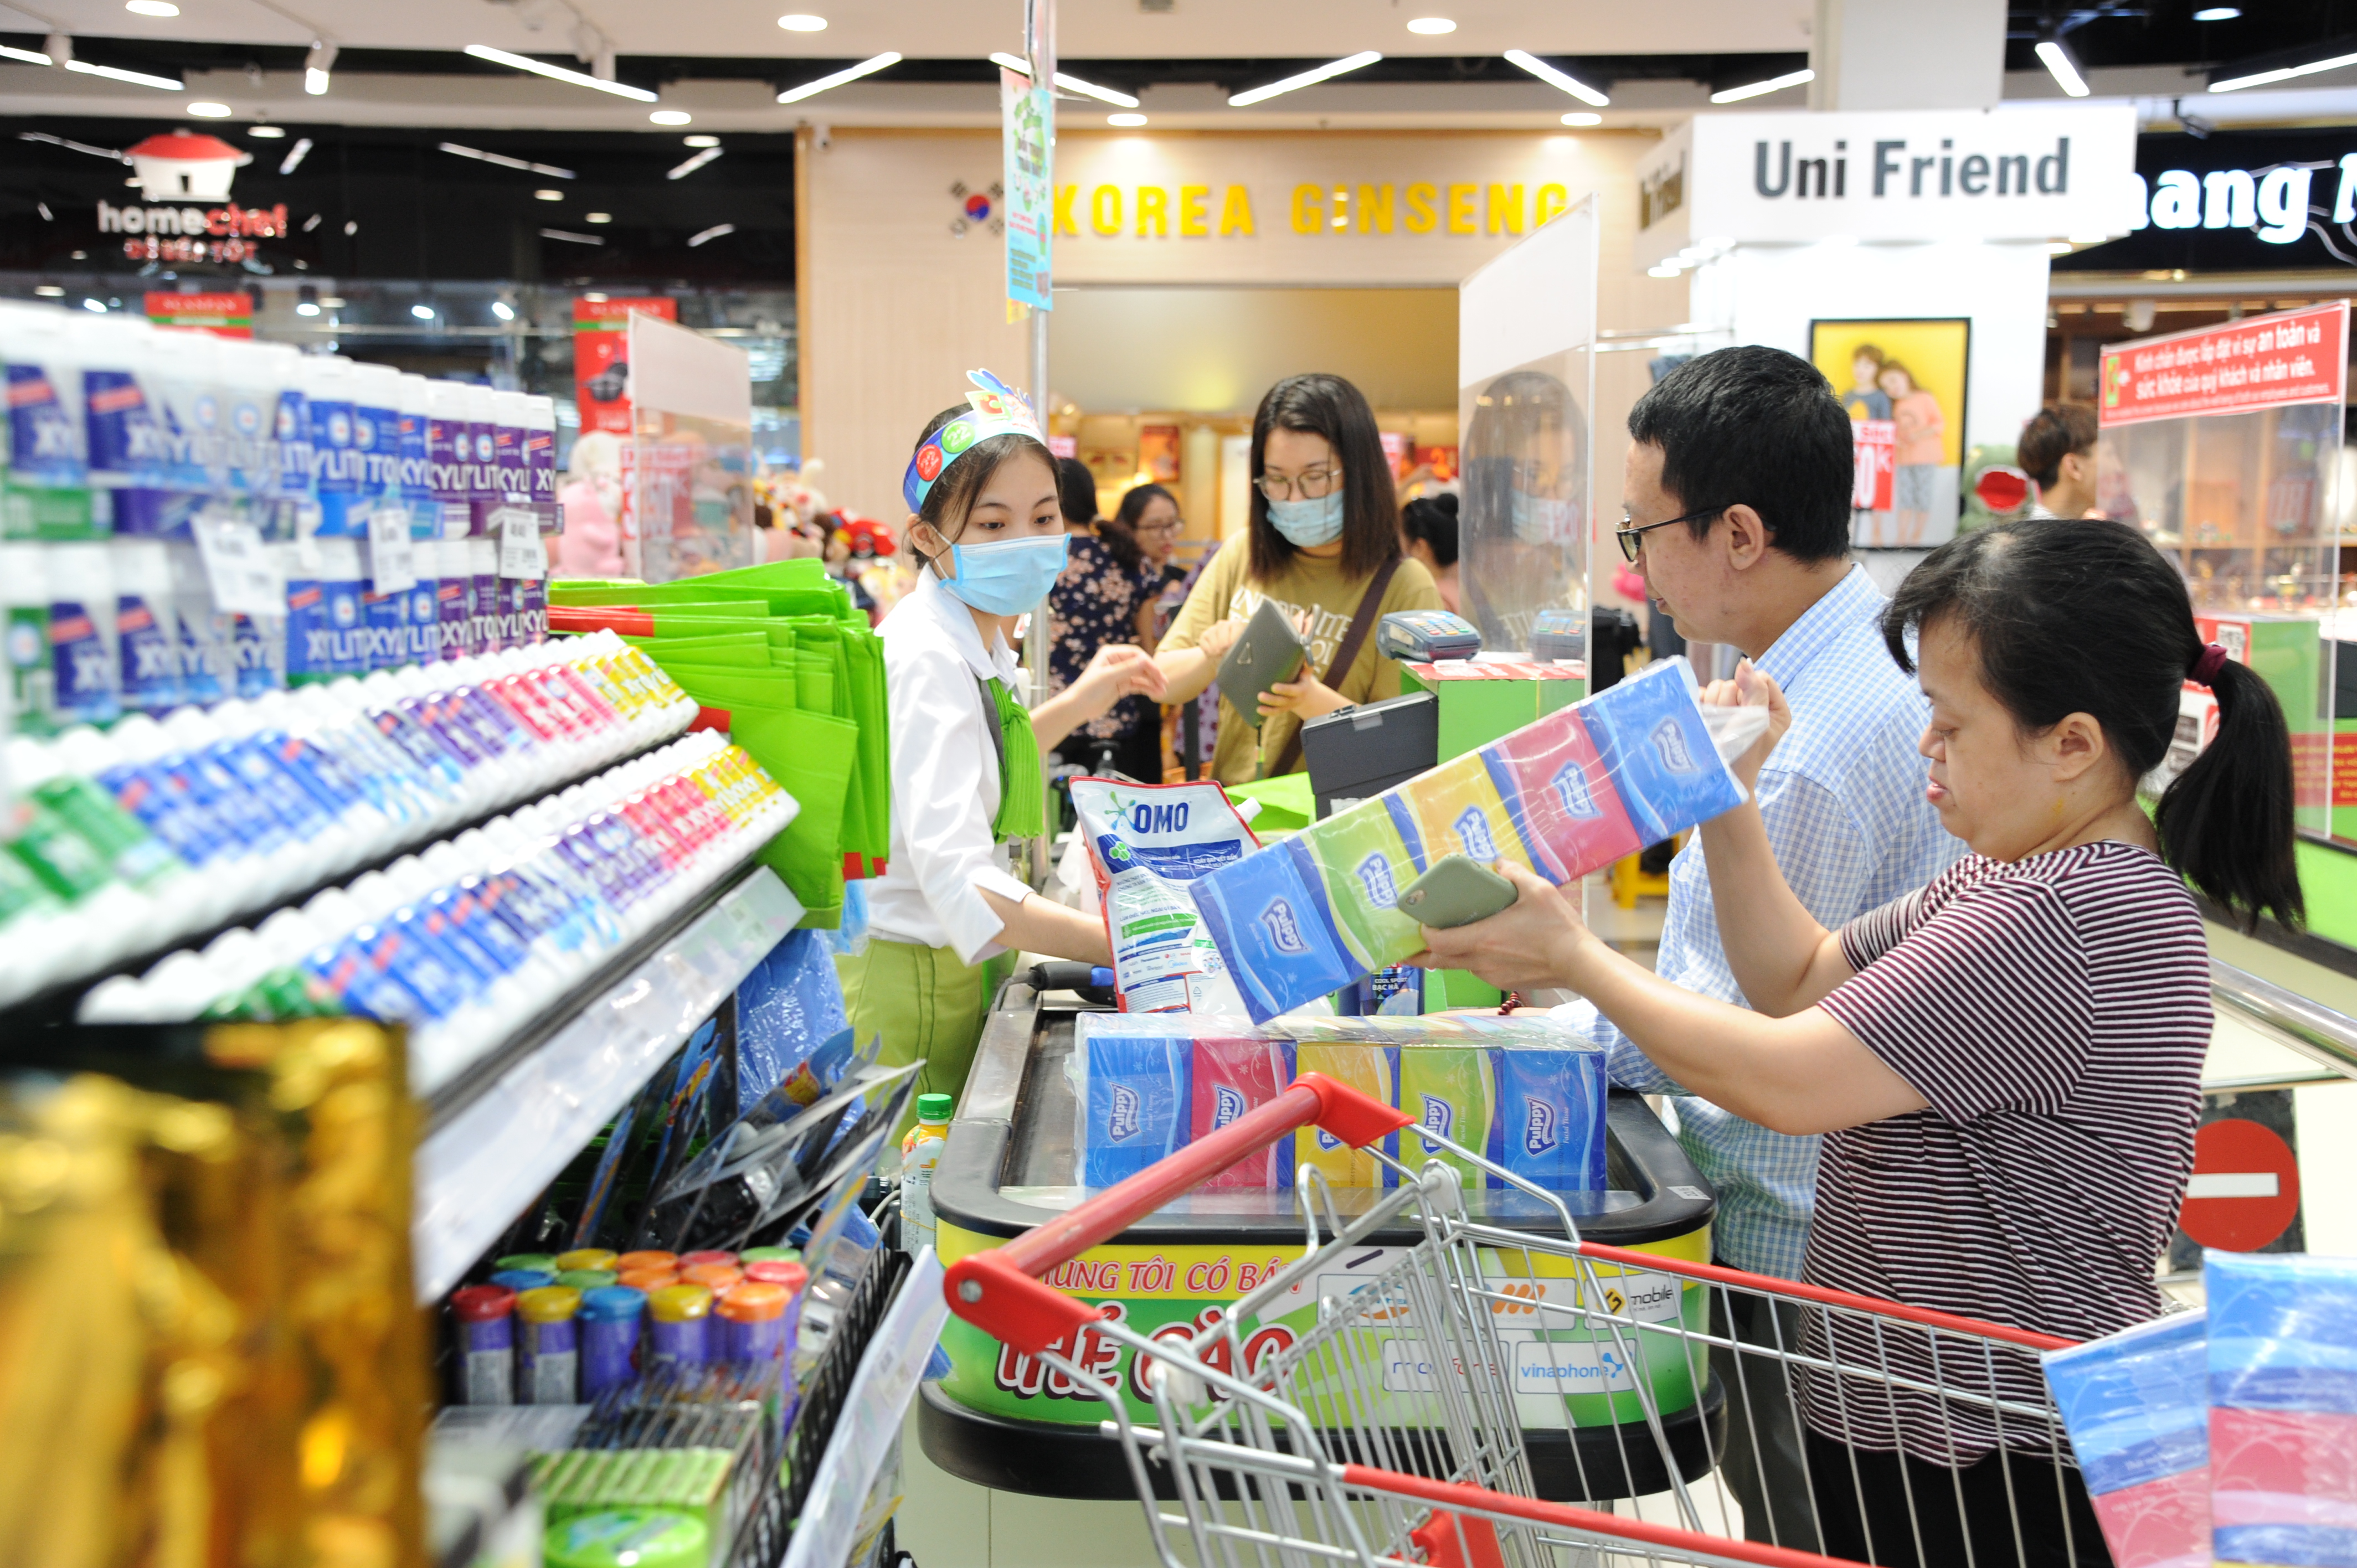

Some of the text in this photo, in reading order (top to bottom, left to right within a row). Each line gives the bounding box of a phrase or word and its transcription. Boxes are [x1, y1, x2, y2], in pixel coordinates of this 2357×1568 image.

[1752, 140, 1846, 199] Uni
[1872, 136, 2070, 198] Friend
[1052, 184, 1255, 237] KOREA
[1290, 182, 1567, 236] GINSENG
[1662, 723, 1691, 770] Pulppy
[1135, 802, 1189, 834] OMO
[1273, 901, 1303, 952] Pulppy
[1372, 984, 1388, 992] BẠC
[1112, 1087, 1128, 1136] Pulppy
[1217, 1090, 1234, 1127] ulppy
[1529, 1101, 1544, 1149] Pulppy
[1128, 1255, 1177, 1292] TÔI
[1185, 1255, 1231, 1293] CÓ
[1630, 1284, 1673, 1306] mobile
[1521, 1363, 1609, 1380] vinaphone
